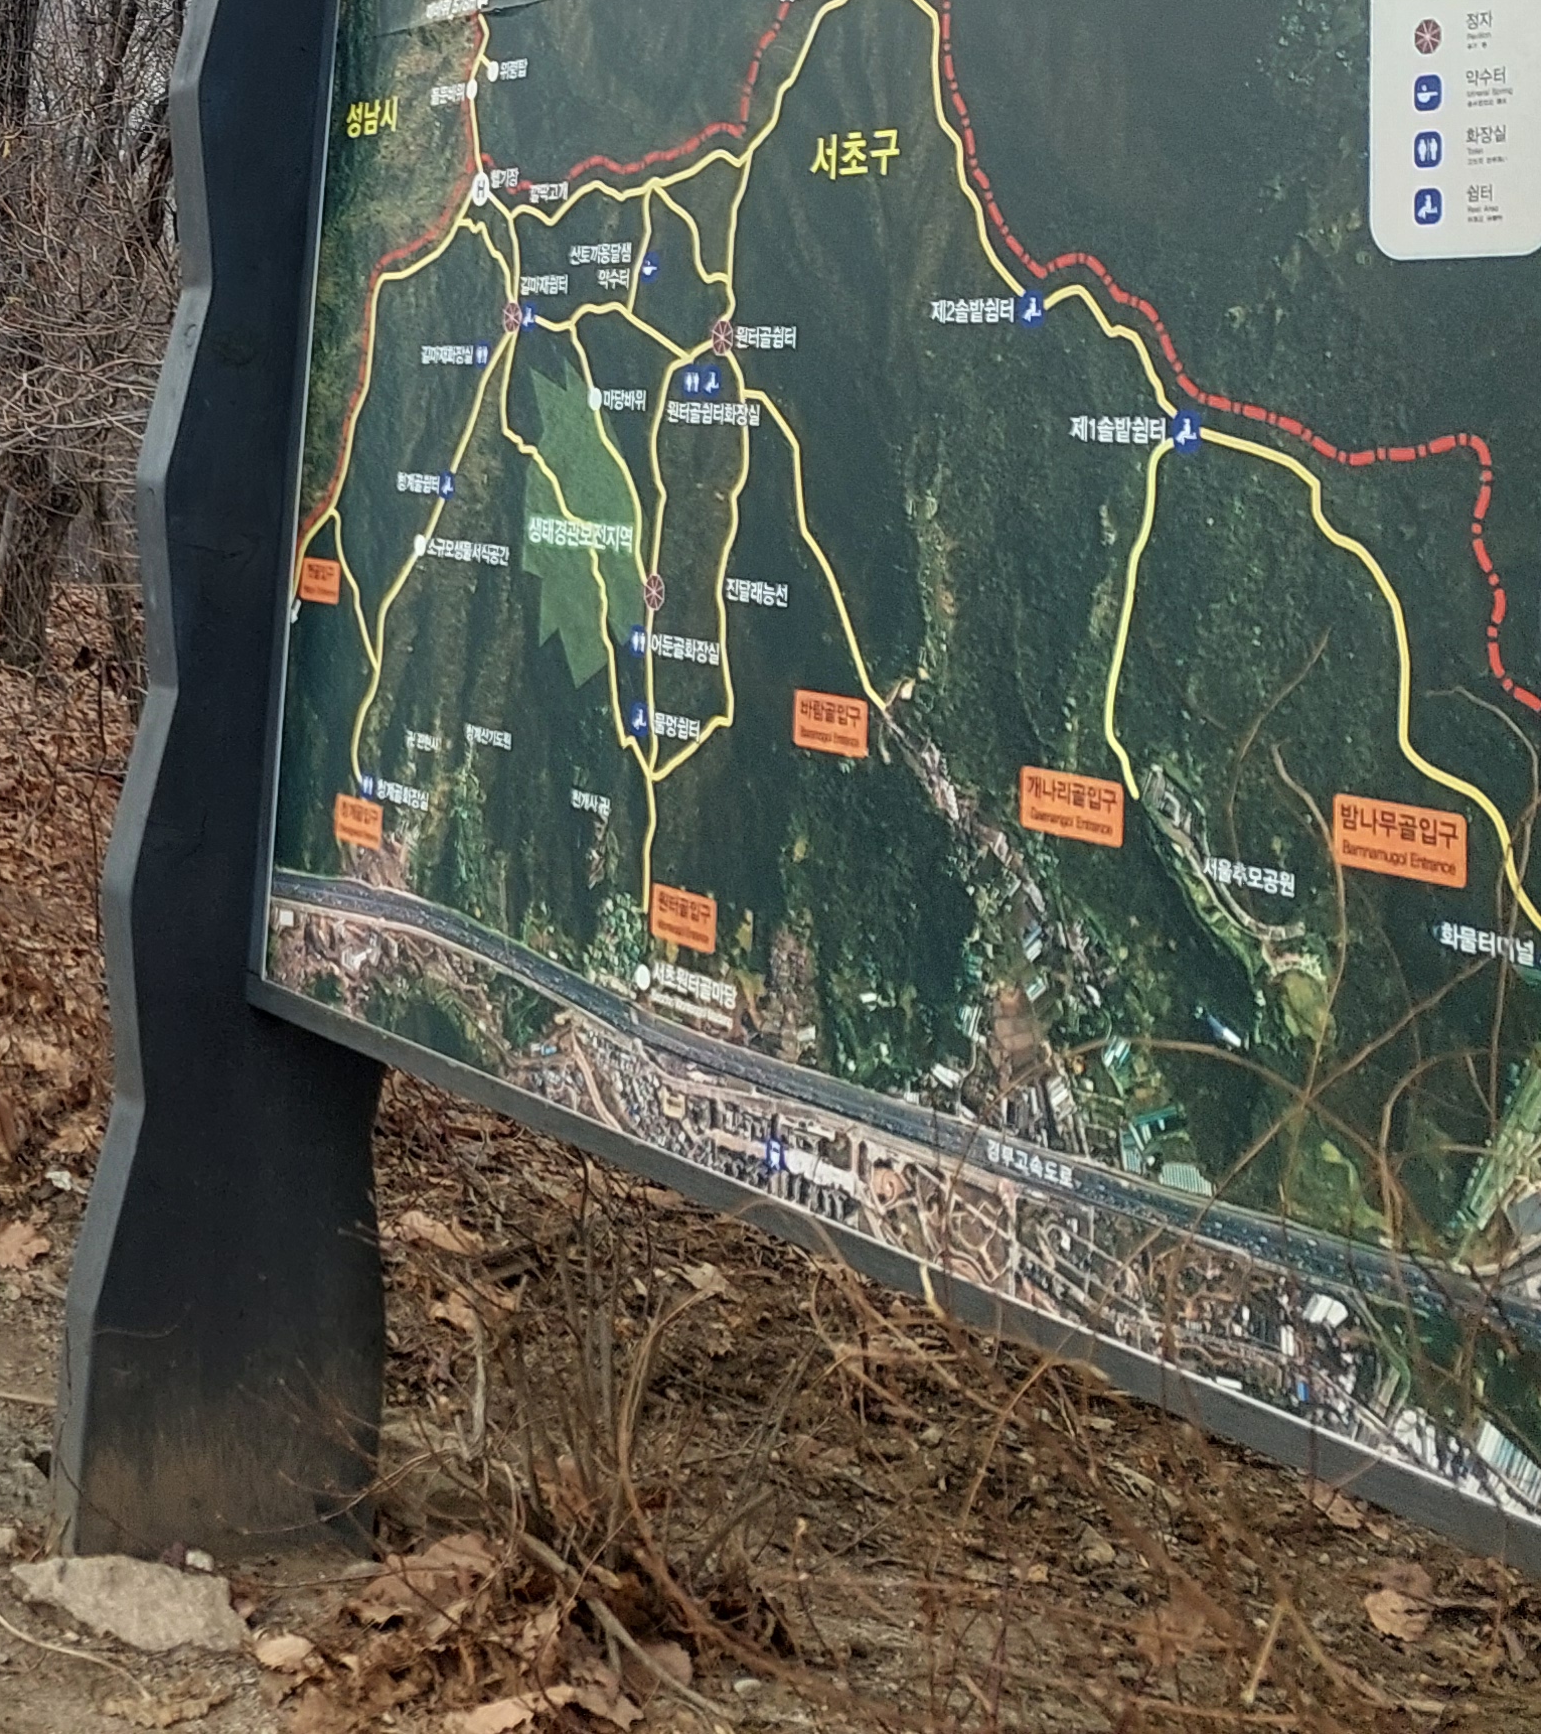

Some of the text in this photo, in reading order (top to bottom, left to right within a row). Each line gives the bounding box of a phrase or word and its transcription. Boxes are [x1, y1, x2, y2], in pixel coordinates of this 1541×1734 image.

[1466, 10, 1492, 30] 정자
[1466, 66, 1506, 87] 약수터
[346, 96, 398, 138] 성남시
[1466, 125, 1506, 144] 화장실
[809, 129, 900, 180] 서초구
[1467, 184, 1493, 203] 쉼터
[569, 242, 632, 265] 산토끼옹달샘
[520, 274, 568, 295] 길마재쉼터
[597, 269, 630, 290] 약수터
[930, 297, 1014, 324] 제2솔밭쉼터
[735, 326, 797, 349] 원터골쉼터
[603, 390, 646, 411] 마당바위
[667, 400, 760, 426] 원터골쉼터화장실
[1069, 416, 1166, 444] 제1솔밭쉼터
[528, 516, 633, 553] 생태경관보전지역
[726, 577, 788, 607] 진달래능선
[650, 634, 720, 666] 어둔골화장실
[800, 700, 861, 727] 바람골입구
[377, 779, 429, 811] 청계골화장실
[1027, 775, 1117, 814] 개나리골입구
[1341, 803, 1458, 849] 밤나무골입구
[1203, 856, 1295, 898] 서울추모공원
[1410, 853, 1456, 876] Entrance
[1440, 921, 1534, 966] 화물터미널
[986, 1138, 1073, 1188] 경부고속도로
